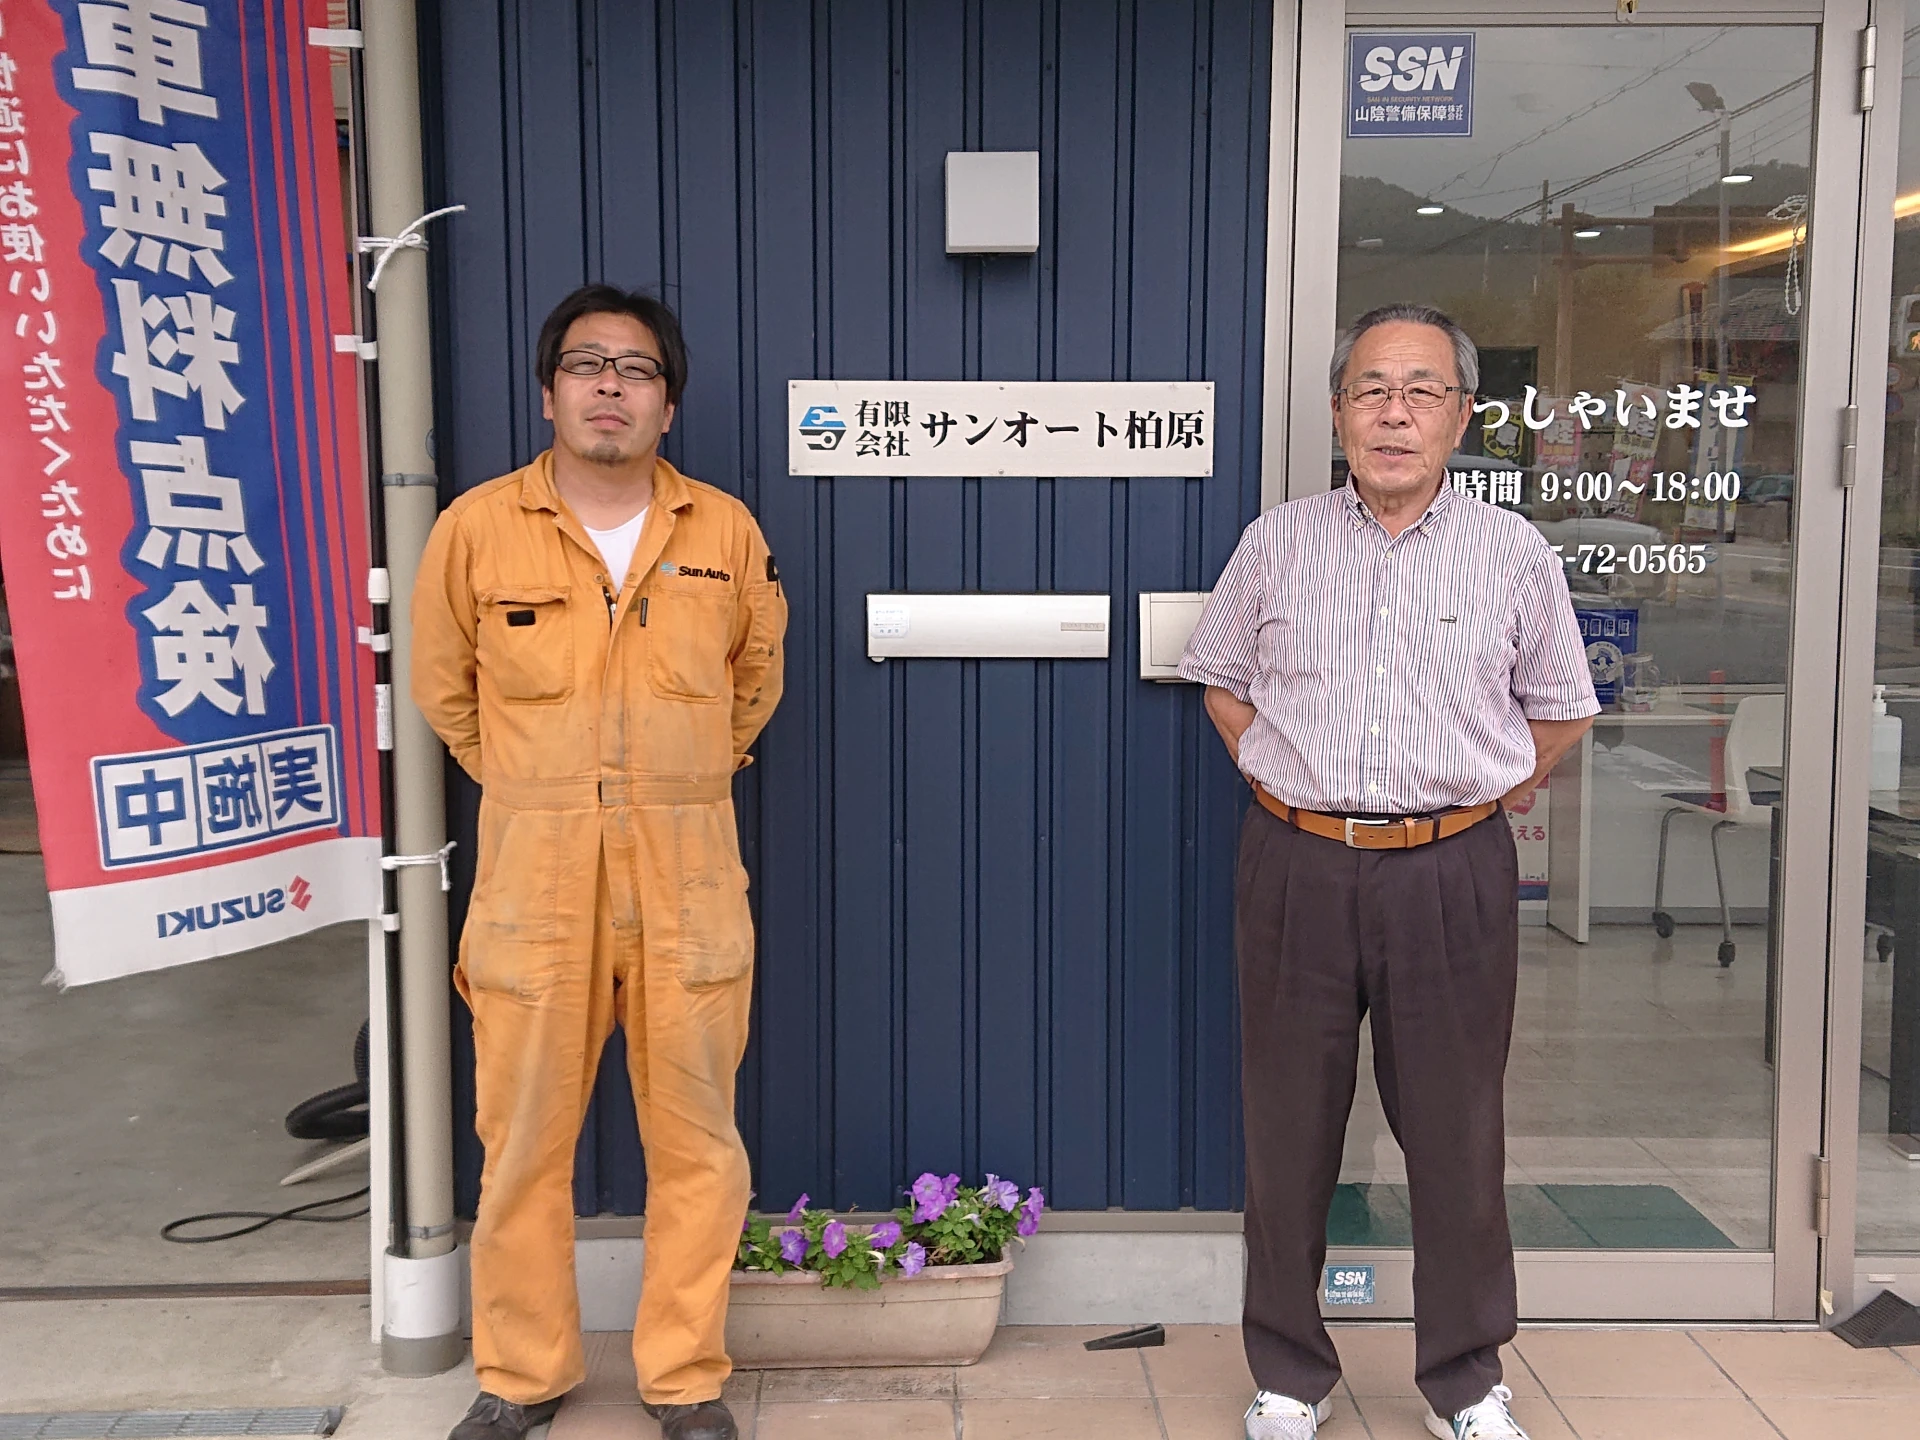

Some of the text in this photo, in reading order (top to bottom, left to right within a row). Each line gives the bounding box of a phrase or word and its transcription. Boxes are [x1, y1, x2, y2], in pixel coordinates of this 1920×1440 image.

[1359, 46, 1464, 92] SSN
[1355, 104, 1447, 122] 山陰警備保障
[1390, 95, 1422, 104] SECURITY
[1422, 95, 1454, 104] NETWORK
[855, 399, 911, 428] 有限
[1472, 384, 1757, 430] っしゃいませ
[855, 409, 1205, 458] 会社 サンオート柏原
[1449, 470, 1523, 506] 時間
[1510, 825, 1546, 842] える
[1333, 1271, 1367, 1286] SSN
